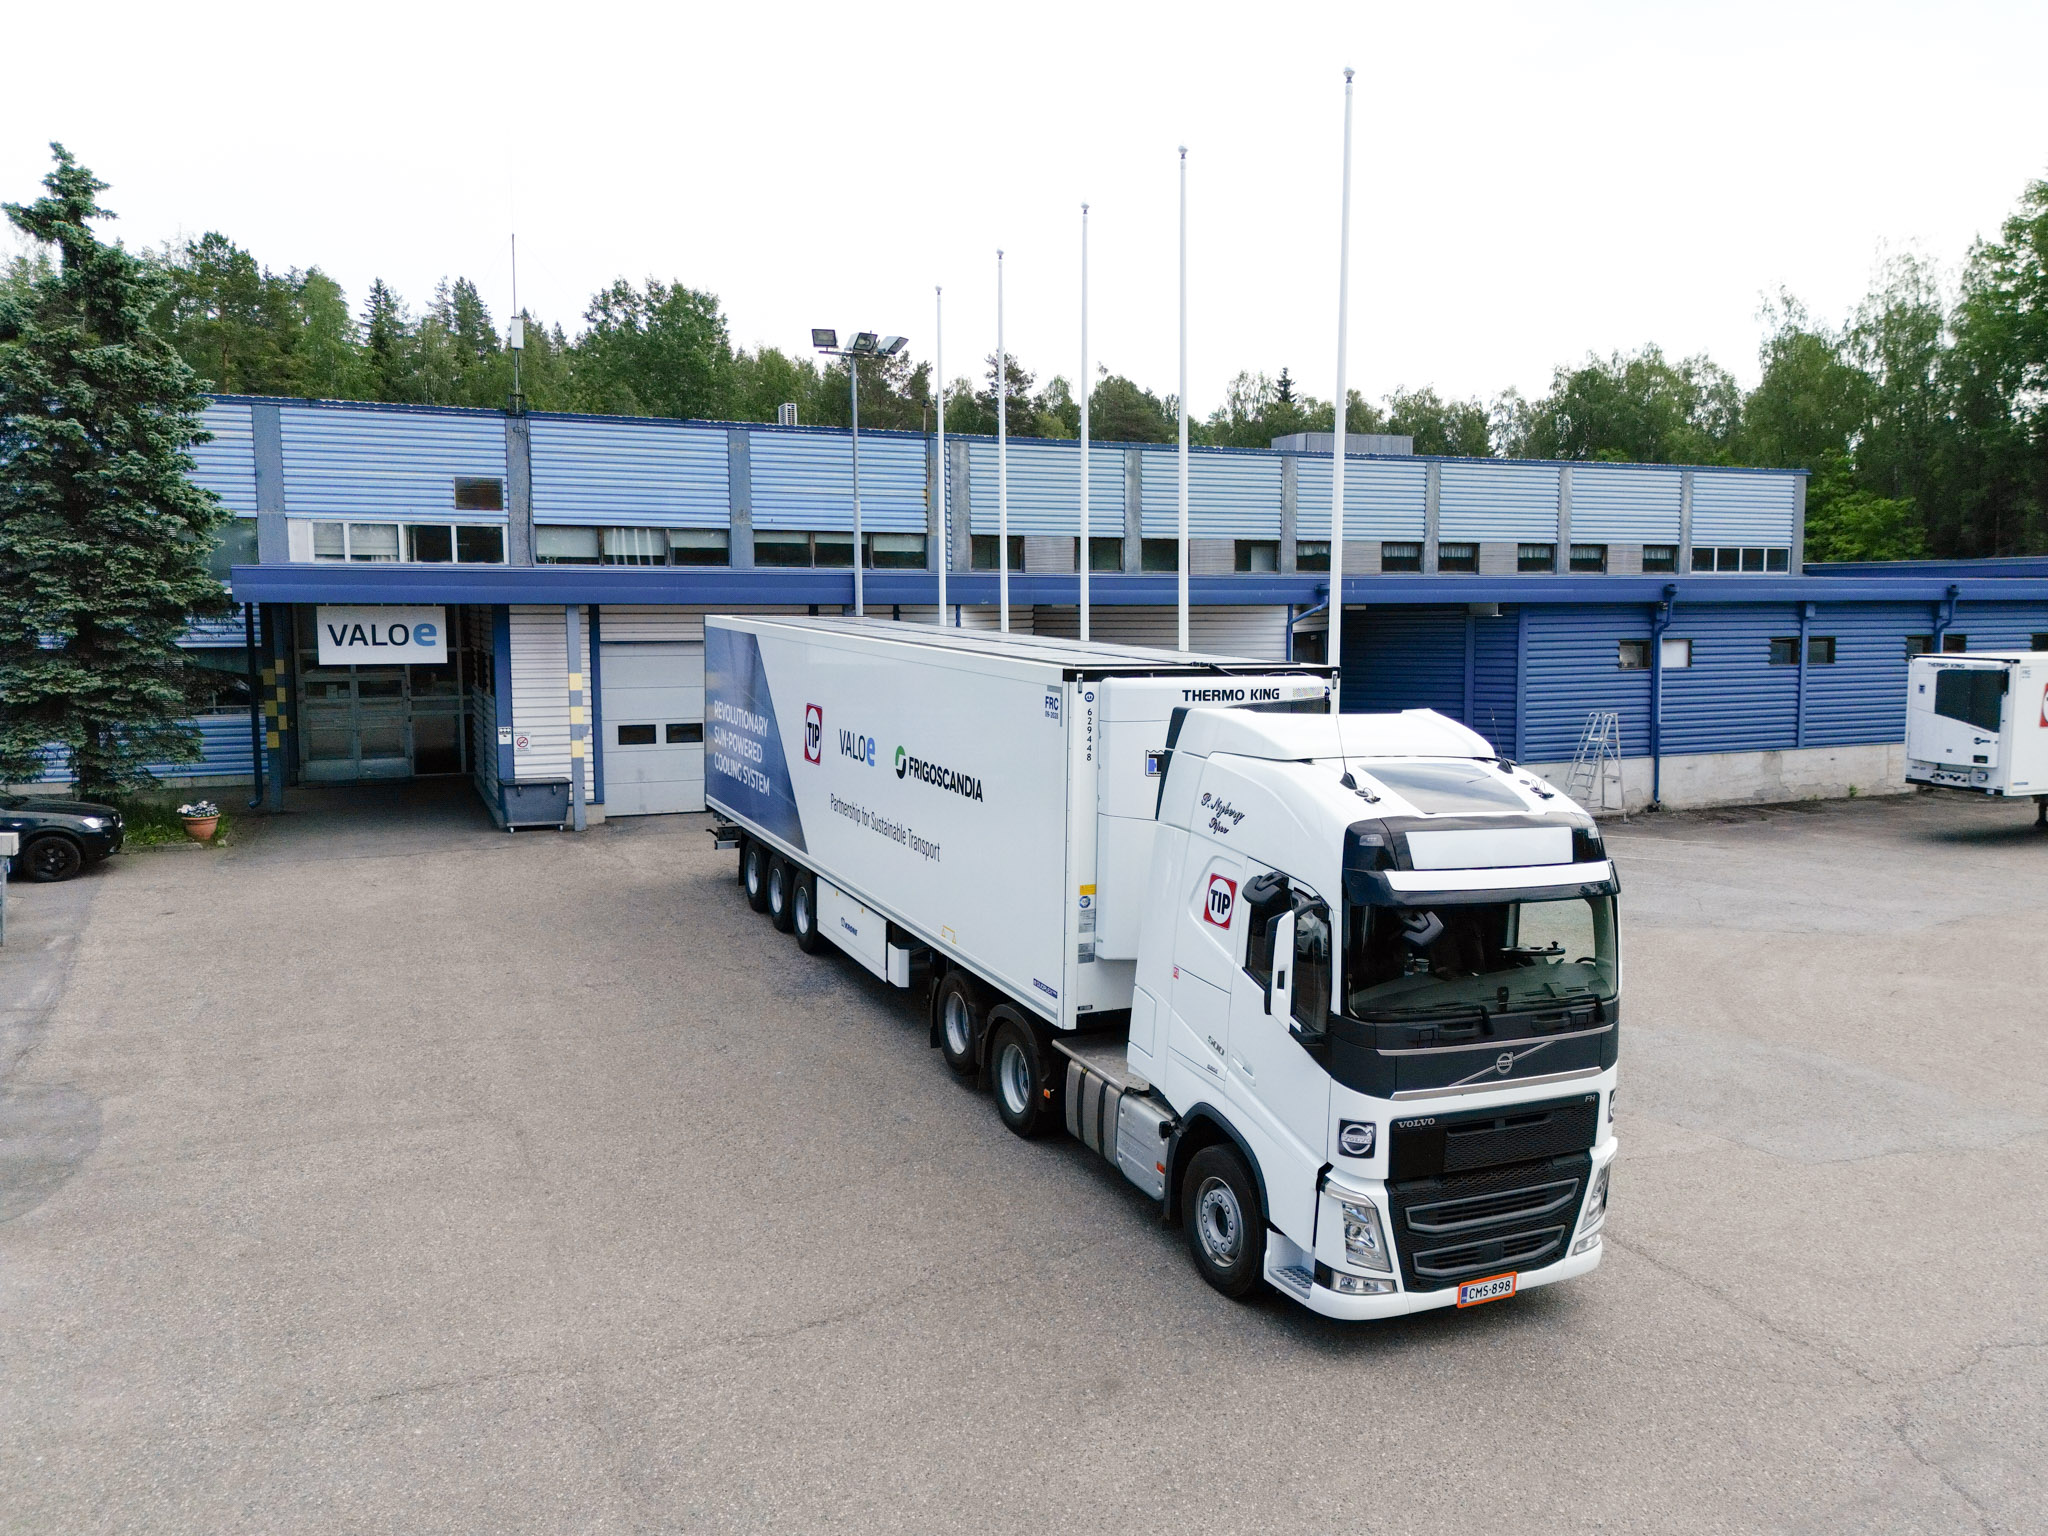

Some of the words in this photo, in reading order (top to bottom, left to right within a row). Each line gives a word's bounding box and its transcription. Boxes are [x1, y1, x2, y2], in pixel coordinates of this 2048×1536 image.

[1045, 695, 1059, 711] FRC
[1182, 689, 1245, 702] THERMO
[1250, 688, 1280, 701] KING
[714, 700, 769, 737] REVOLUTIONARY
[714, 725, 763, 763] SUN-POWERED
[807, 722, 820, 749] TIP
[714, 751, 742, 782] COOLING
[743, 765, 770, 797] SYSTEM
[908, 756, 984, 803] FRIGOSCANDIA
[830, 793, 861, 827] Partnership
[861, 806, 870, 827] for
[870, 811, 907, 846] Sustainable
[907, 828, 941, 862] Transport
[1210, 889, 1231, 915] TIP
[1207, 1035, 1225, 1056] 500
[1584, 1094, 1596, 1103] FH
[1397, 1117, 1435, 1129] VOLVO
[1469, 1280, 1511, 1299] CMS-898
